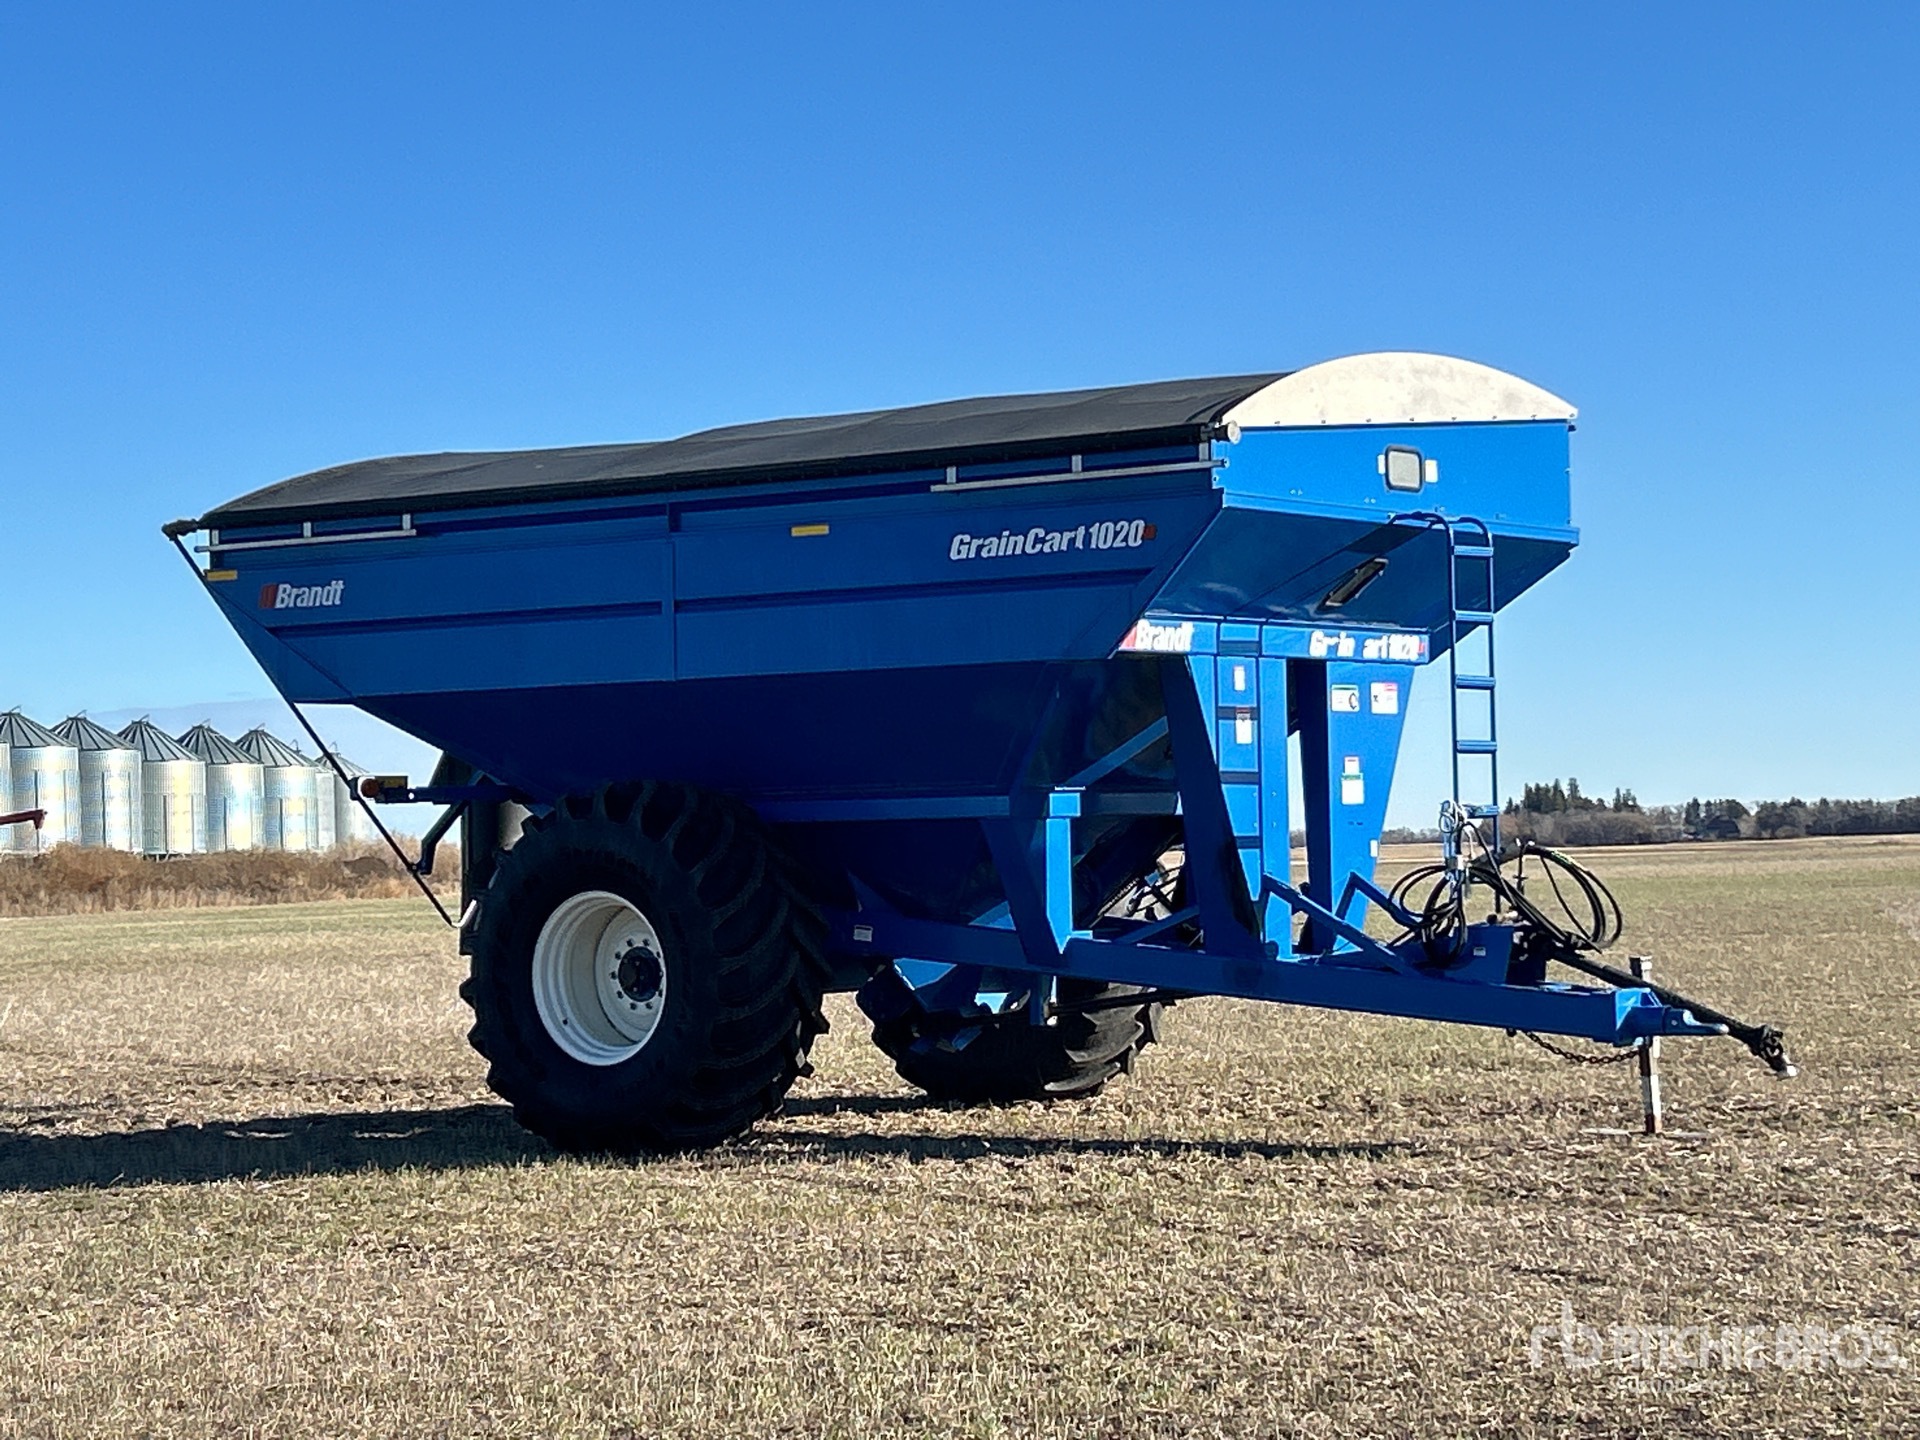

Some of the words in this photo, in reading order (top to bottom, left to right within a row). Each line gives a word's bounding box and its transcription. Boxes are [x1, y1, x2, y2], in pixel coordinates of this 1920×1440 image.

[949, 525, 1086, 561] GrainCart
[1089, 519, 1145, 549] 1020
[274, 580, 345, 609] Brandt
[1135, 619, 1194, 652] Brandt
